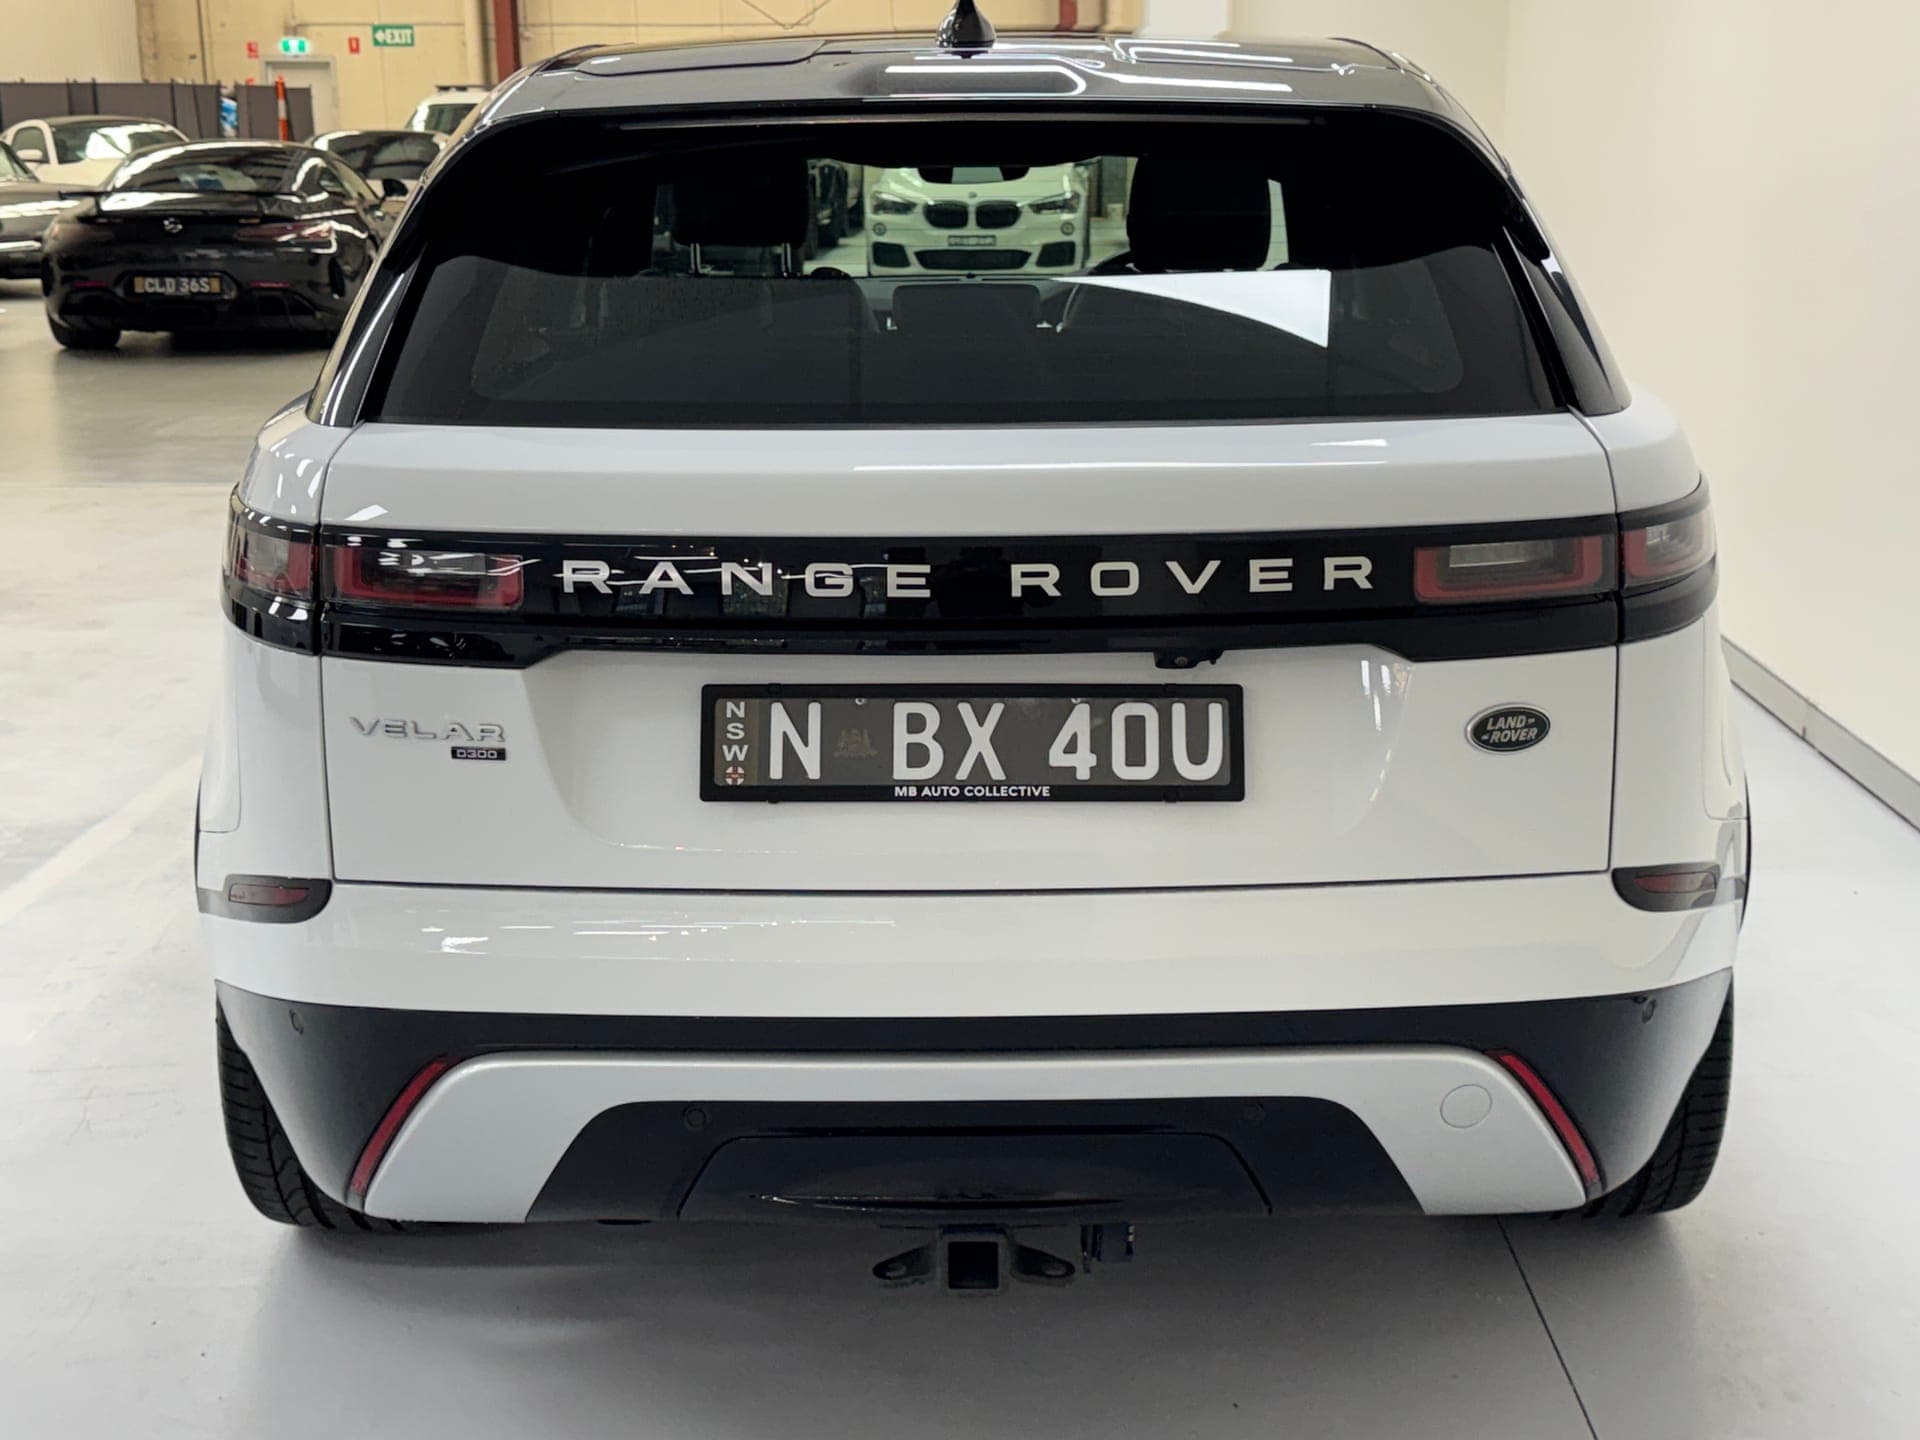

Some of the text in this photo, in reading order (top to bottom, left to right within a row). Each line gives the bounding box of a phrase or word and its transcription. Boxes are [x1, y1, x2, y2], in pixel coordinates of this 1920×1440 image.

[386, 29, 411, 44] EXIT
[562, 555, 1374, 598] RANGE ROVER
[349, 716, 506, 743] VELAR
[1487, 715, 1526, 730] LAND
[769, 702, 821, 779] N
[892, 702, 1007, 780] BX
[1490, 727, 1537, 744] ROVER
[456, 749, 498, 758] D300
[894, 786, 1050, 797] MB AUTO COLLECTIVE
